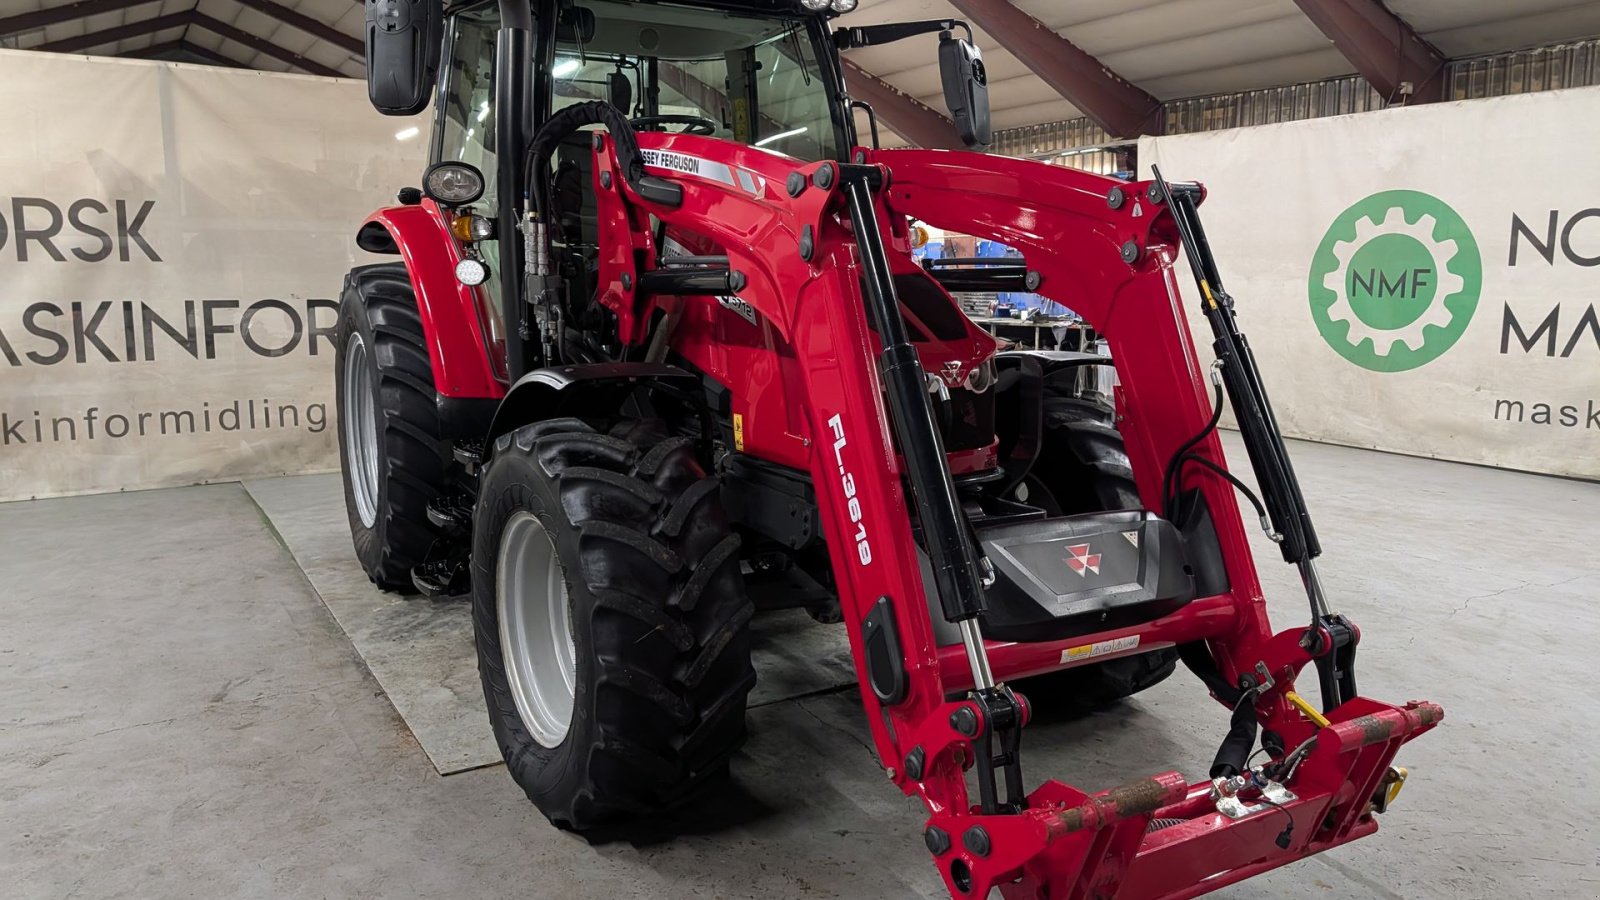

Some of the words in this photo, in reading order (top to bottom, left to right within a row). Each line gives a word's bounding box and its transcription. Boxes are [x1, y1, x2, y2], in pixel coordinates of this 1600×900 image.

[640, 151, 660, 165] SSEY
[661, 153, 700, 174] FERGUSON
[0, 197, 163, 262] RSK
[1508, 208, 1600, 267] NO
[731, 297, 752, 317] 5712
[1352, 268, 1431, 298] NMF
[1500, 300, 1600, 358] MA
[2, 398, 327, 445] kinformidling
[828, 413, 872, 566] FL.3619
